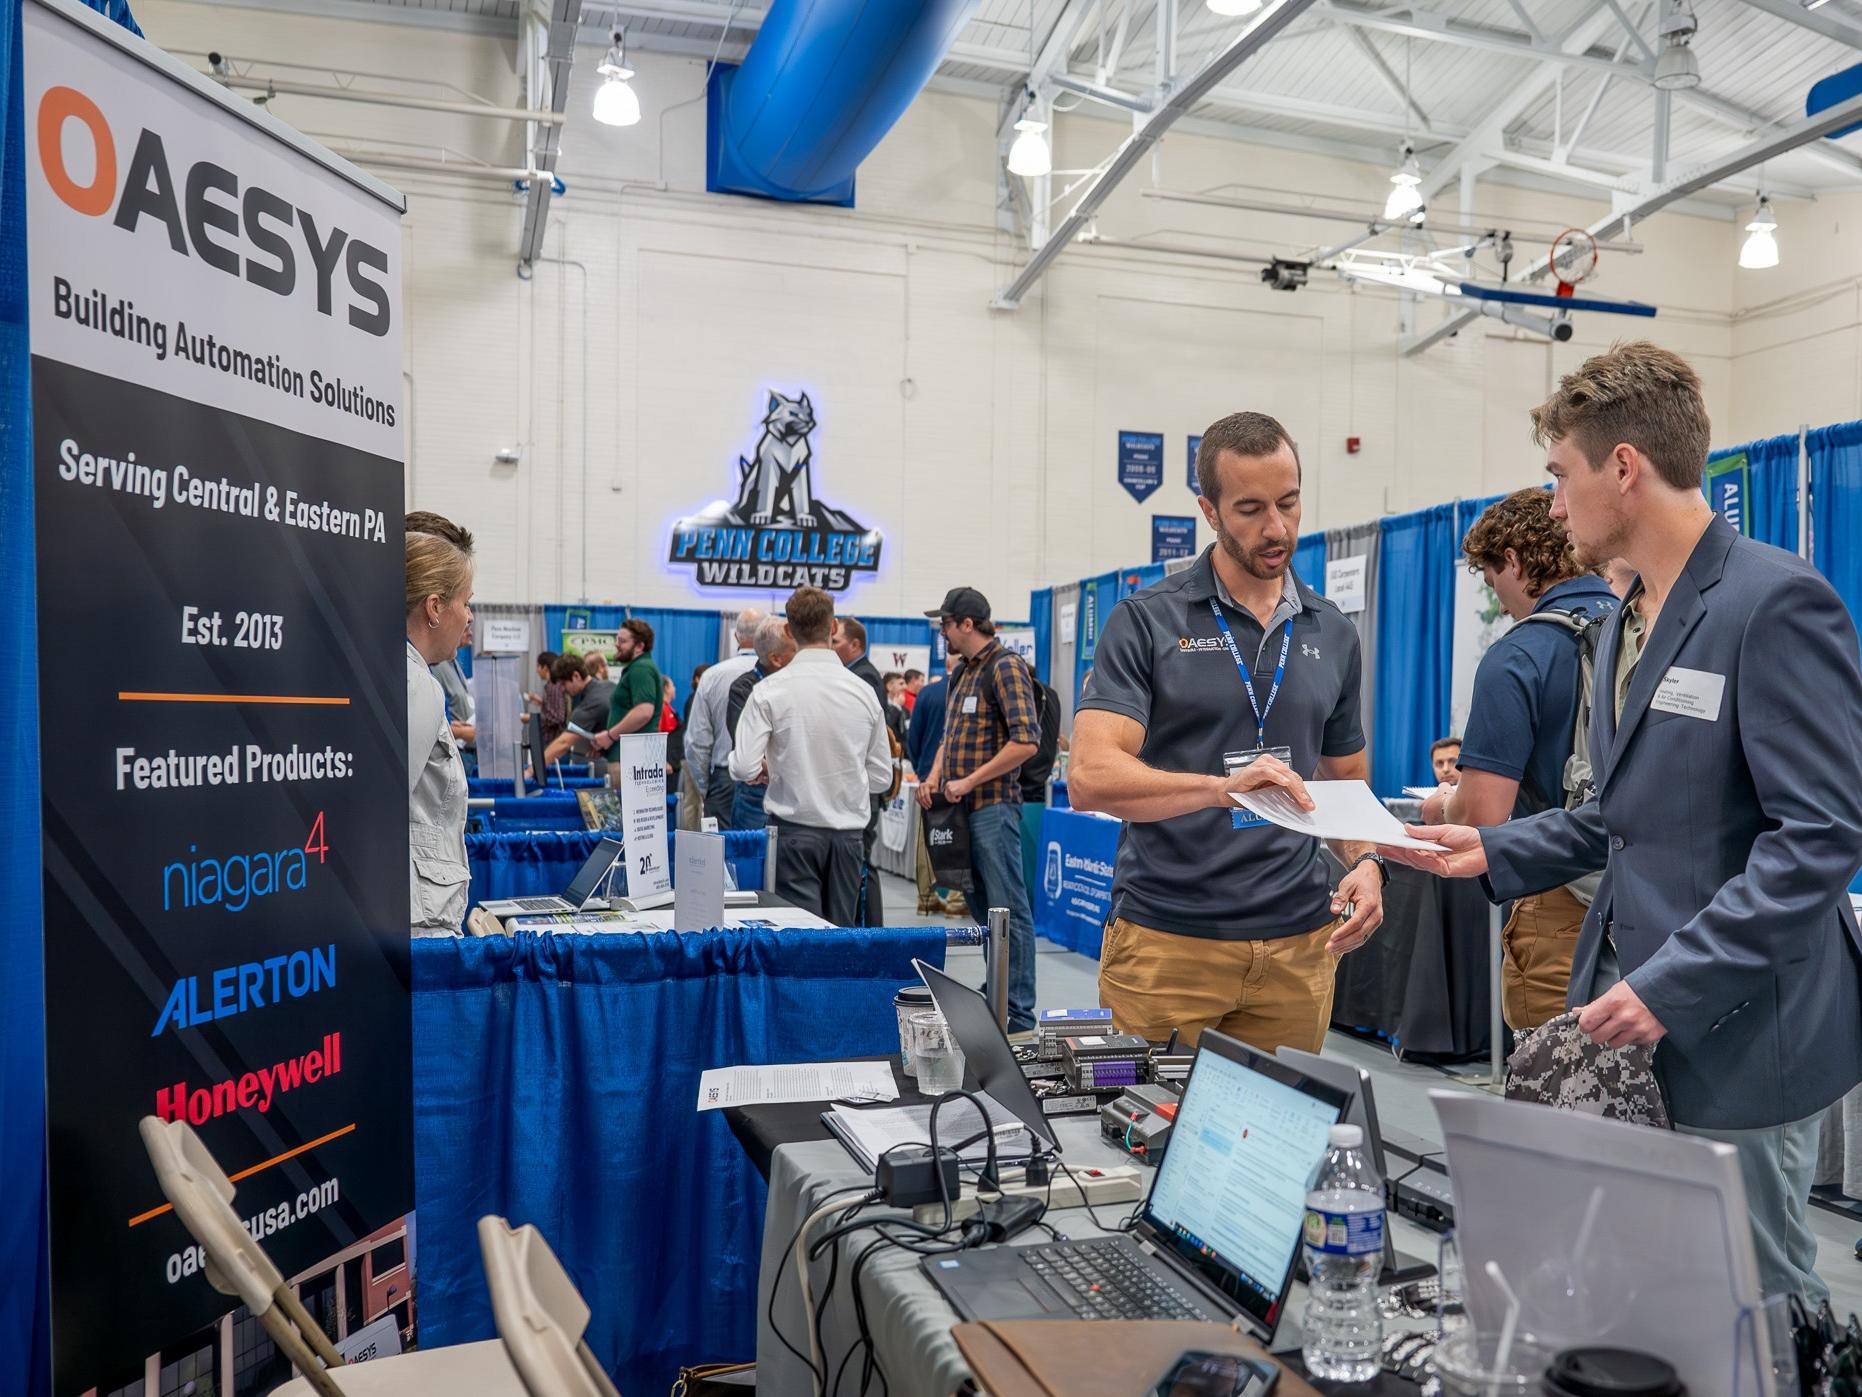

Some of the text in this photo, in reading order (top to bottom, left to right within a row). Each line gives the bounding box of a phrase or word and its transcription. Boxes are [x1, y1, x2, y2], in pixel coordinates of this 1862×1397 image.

[37, 85, 391, 337] OAESYS
[54, 276, 396, 427] Building Automation Solutions
[59, 438, 387, 543] Serving Central & Eastern PA
[676, 527, 875, 567] PENN COLLEGE
[702, 561, 845, 588] WILDCATS
[181, 605, 284, 650] Est. 2013
[116, 743, 354, 790] Featured Products:
[633, 763, 664, 780] Intrada
[1240, 813, 1263, 823] ALU
[151, 944, 337, 1037] ALERTON
[156, 1031, 342, 1126] Honeywell
[166, 1177, 339, 1284] oaeusa.com
